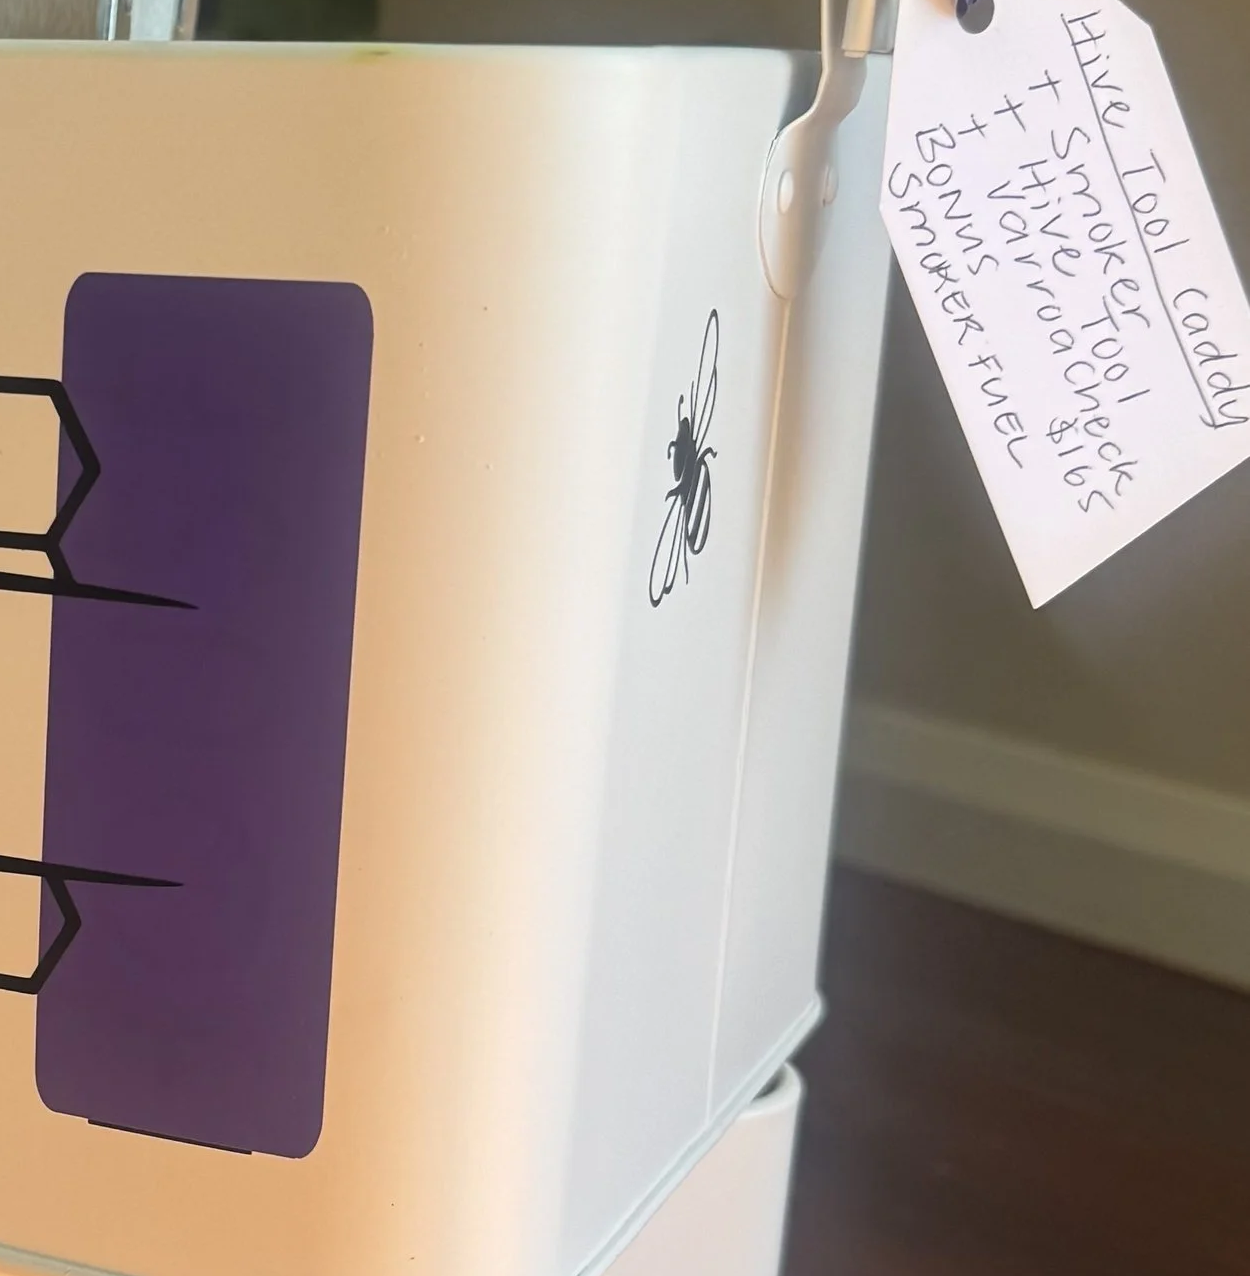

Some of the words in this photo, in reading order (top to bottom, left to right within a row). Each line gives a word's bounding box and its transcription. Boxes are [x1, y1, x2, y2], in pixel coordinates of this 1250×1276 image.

[1050, 126, 1151, 329] Smoker
[1067, 9, 1131, 129] Hive
[1121, 148, 1191, 254] Tool
[1018, 159, 1082, 278] Hive
[1081, 295, 1151, 403] Tool
[967, 353, 1028, 470] FUEL
[1045, 416, 1115, 514] $165
